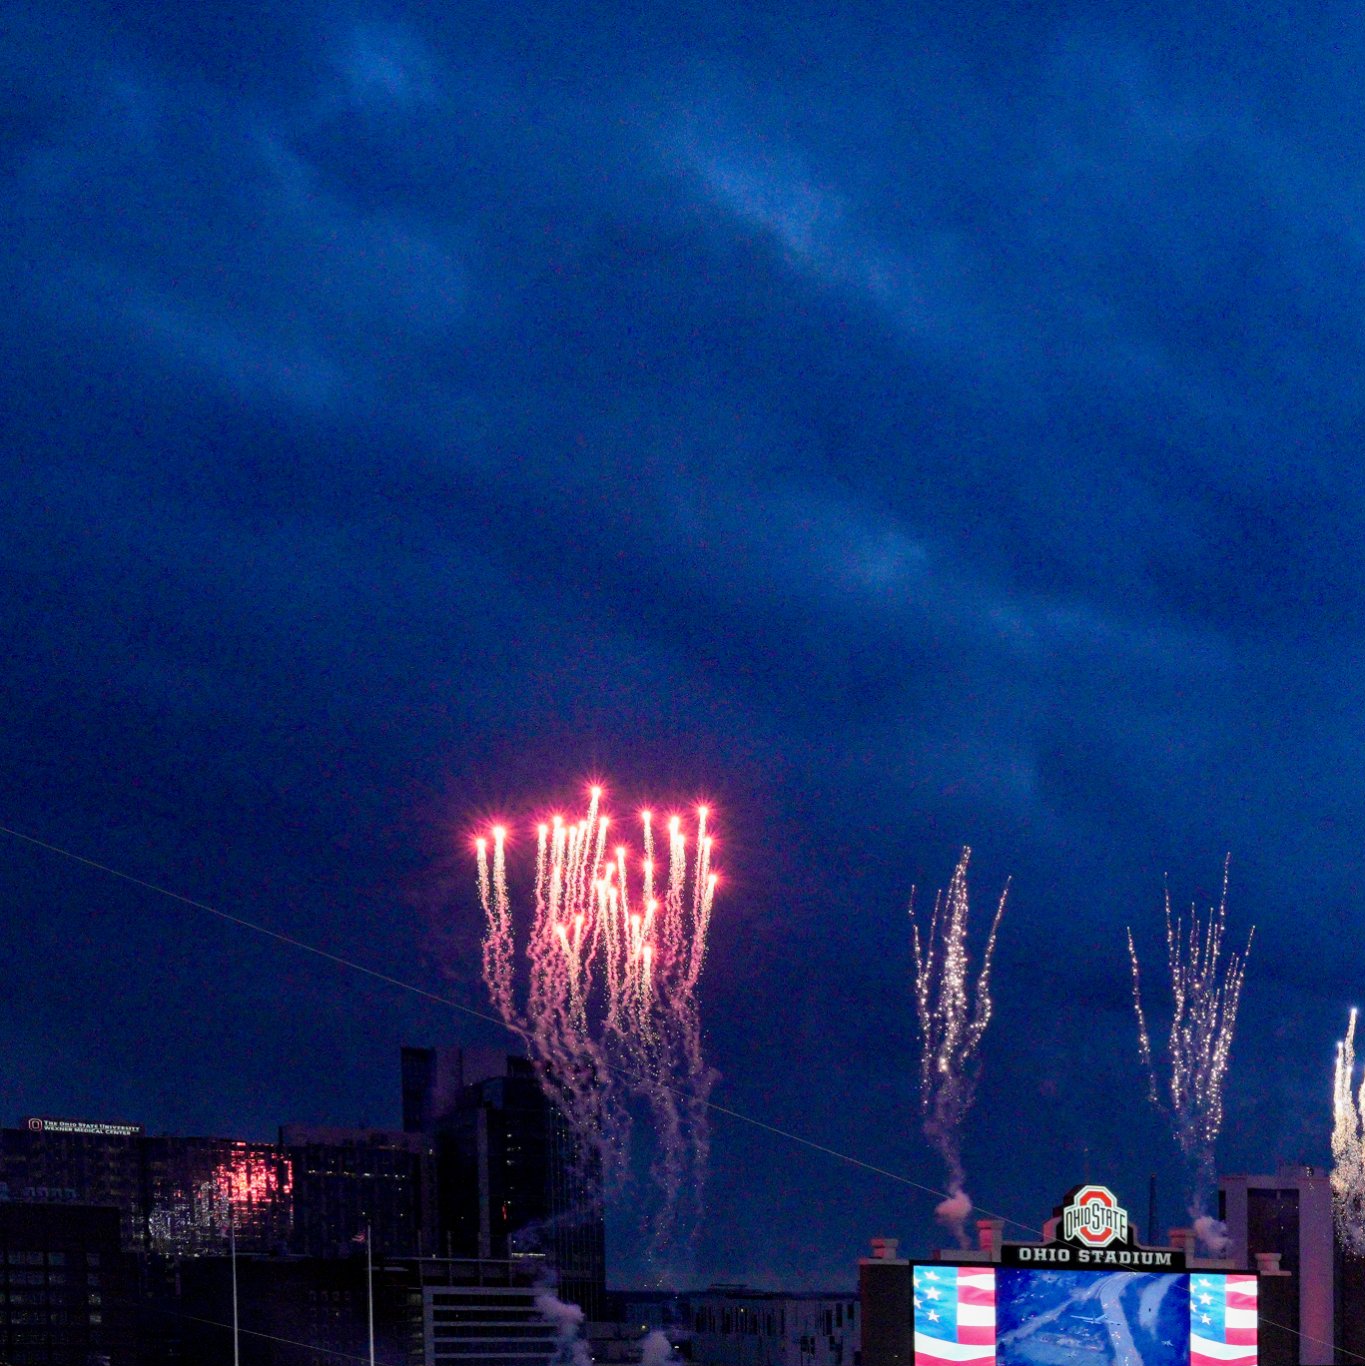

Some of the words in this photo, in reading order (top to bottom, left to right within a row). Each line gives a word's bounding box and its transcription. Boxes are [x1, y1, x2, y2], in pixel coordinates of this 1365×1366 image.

[99, 1123, 140, 1132] UNIVERSITY
[105, 1128, 131, 1136] CENTER
[1065, 1207, 1091, 1238] OHIO
[1091, 1202, 1127, 1243] STATE
[1019, 1247, 1070, 1262] OHIO
[1078, 1249, 1172, 1266] STADIUM
